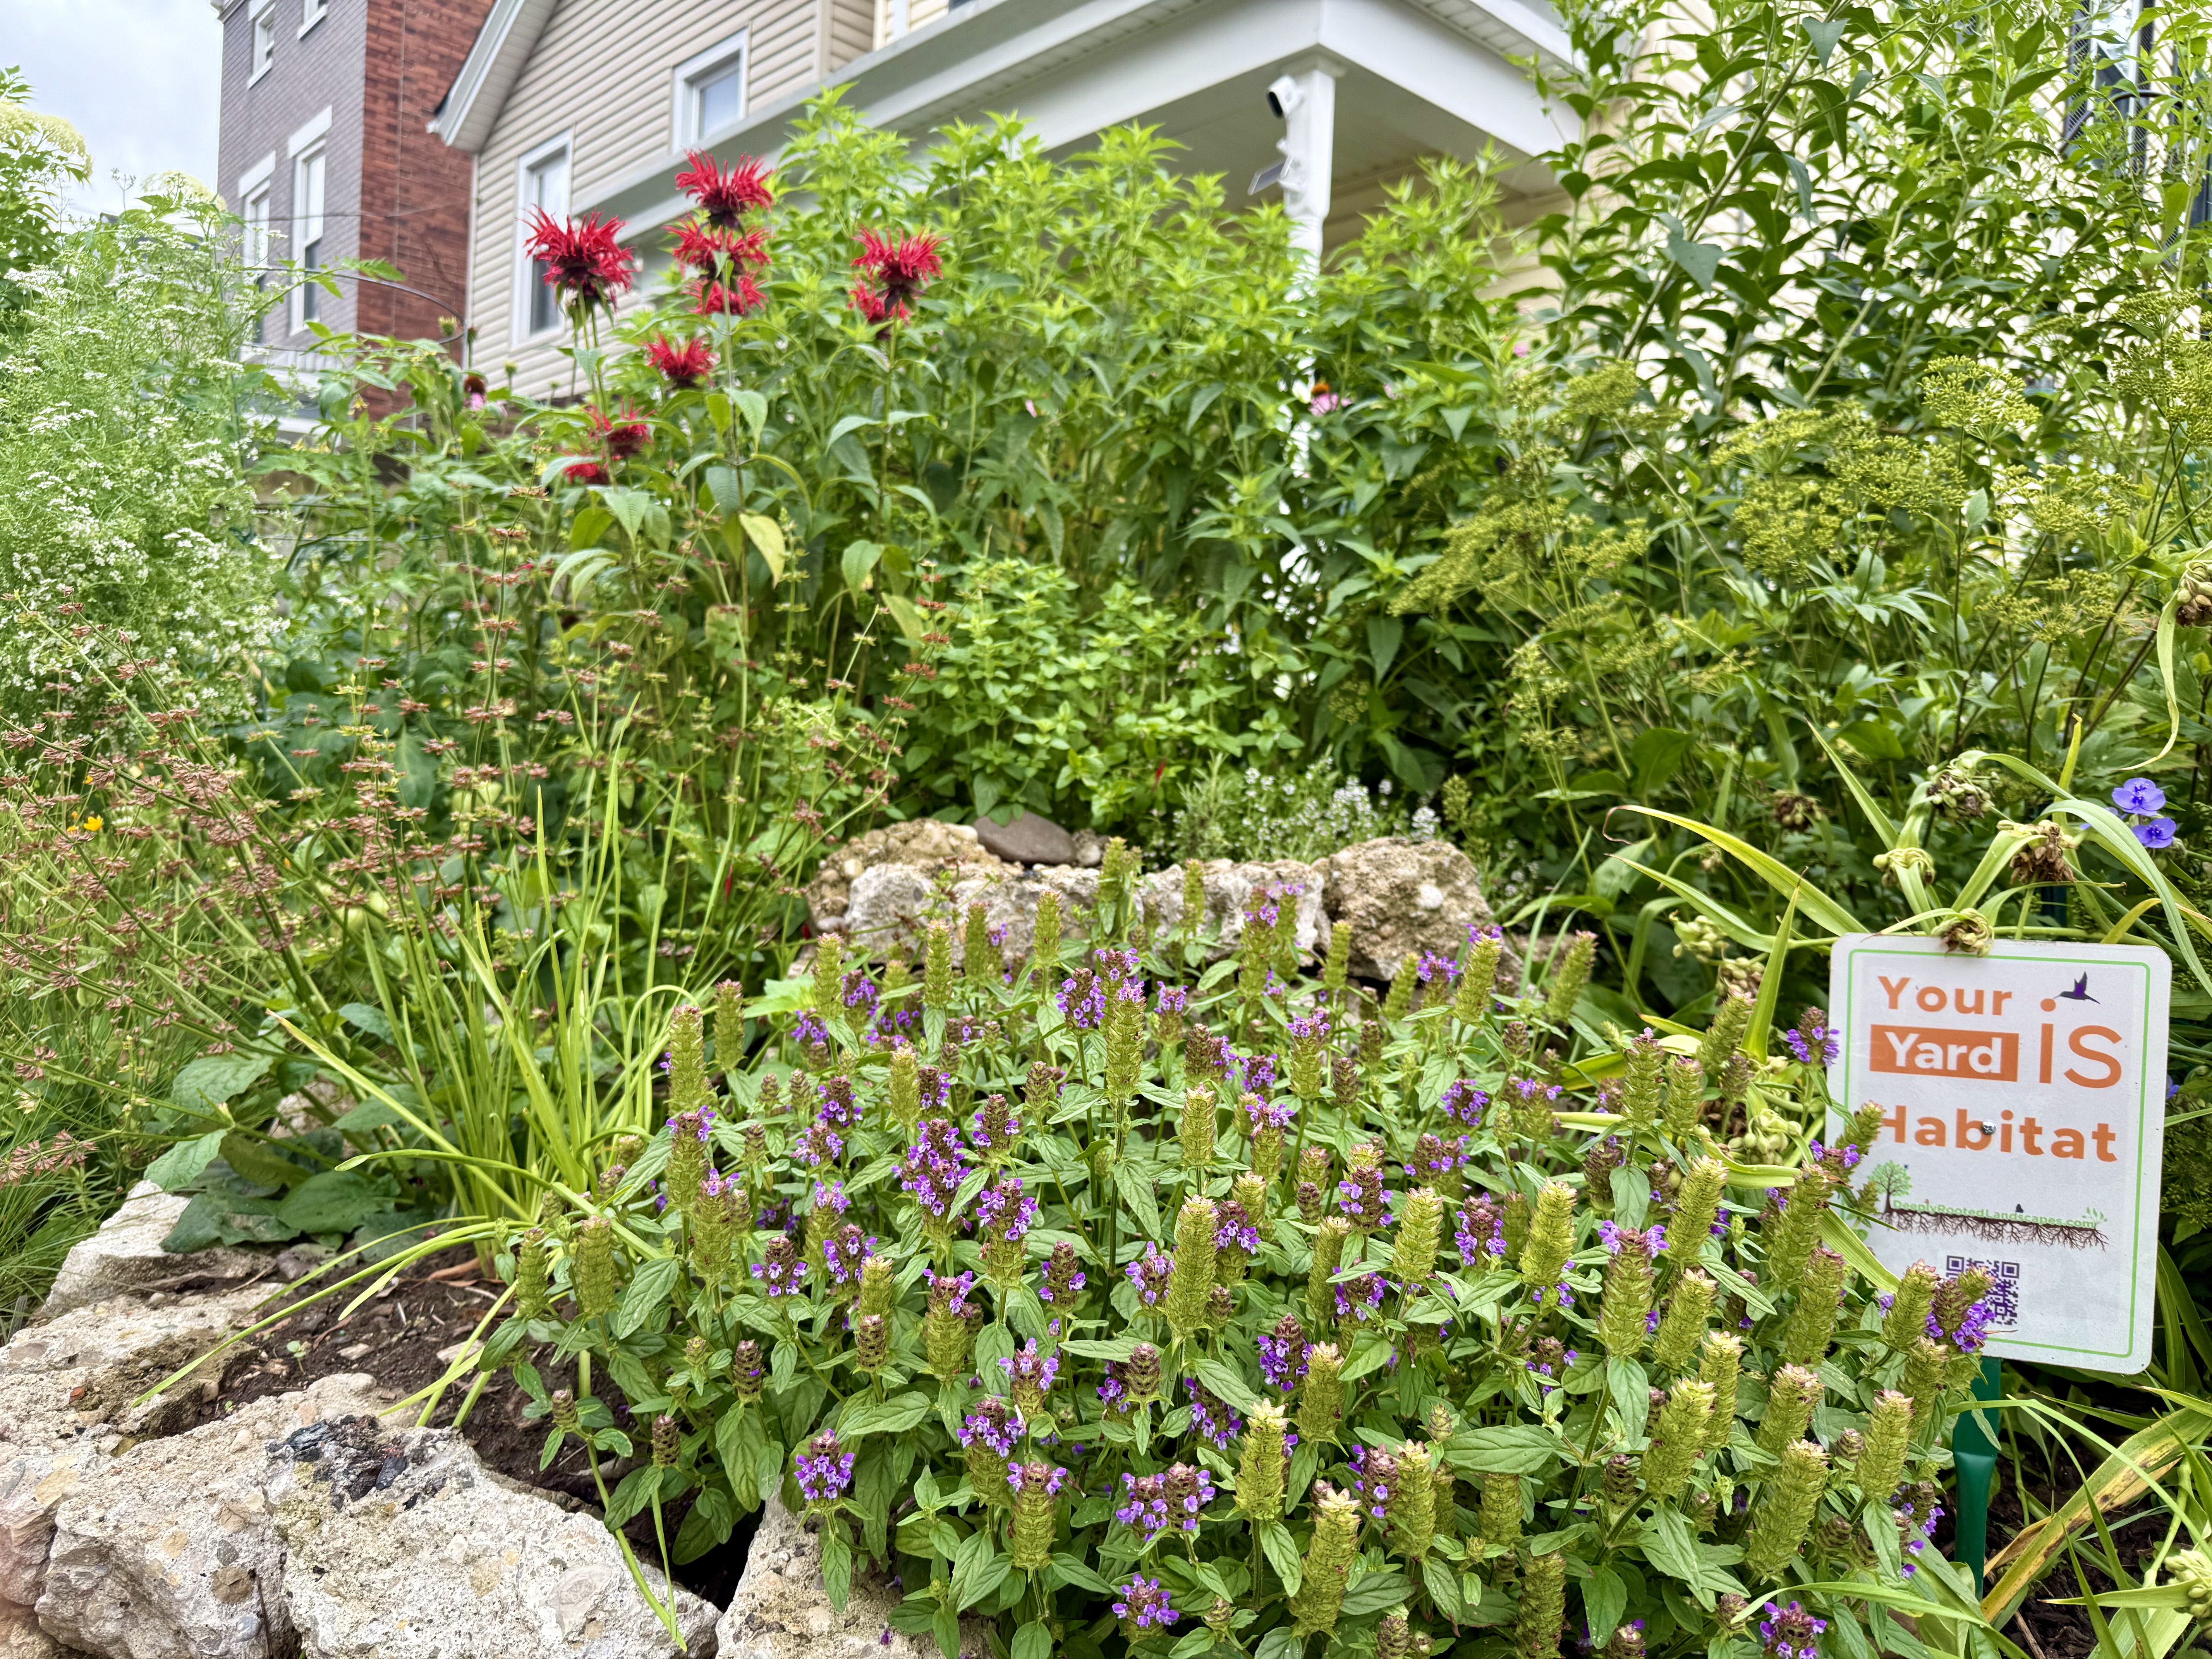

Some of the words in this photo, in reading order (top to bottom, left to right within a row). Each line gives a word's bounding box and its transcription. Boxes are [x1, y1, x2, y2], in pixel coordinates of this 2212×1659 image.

[1877, 975, 2012, 1015] Your
[1884, 1031, 2002, 1073] Yard
[1874, 1104, 2118, 1162] Habitat
[1893, 1200, 2094, 1229] DeeplyRootedLandscapes.com
